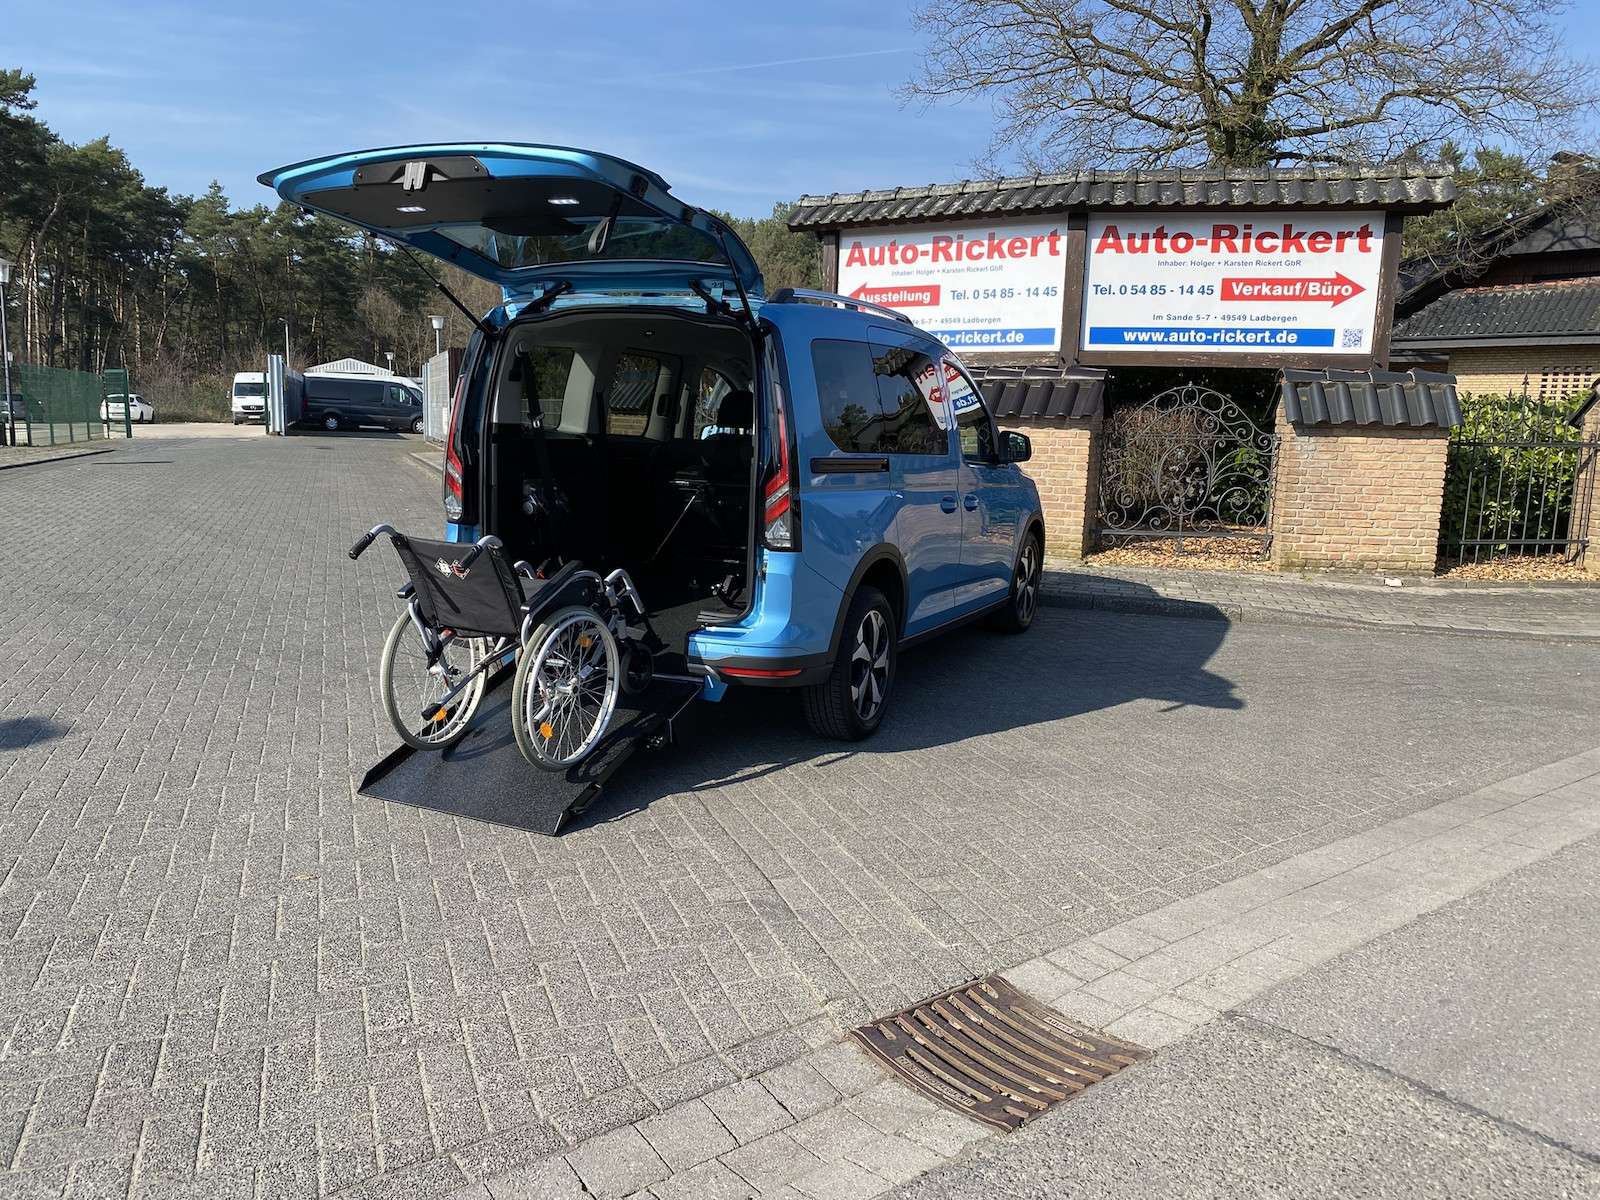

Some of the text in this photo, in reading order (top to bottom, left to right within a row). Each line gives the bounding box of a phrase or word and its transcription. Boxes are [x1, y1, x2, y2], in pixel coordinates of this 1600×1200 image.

[1095, 223, 1373, 255] Auto-Rickert
[846, 228, 1061, 268] Auto-Rickert
[1190, 259, 1215, 268] Holger
[1223, 259, 1253, 267] Karsten
[1255, 259, 1283, 267] Rickert
[1284, 259, 1302, 267] GbR
[950, 289, 969, 300] Tel.
[972, 289, 980, 300] 0
[982, 288, 997, 299] 54
[999, 287, 1014, 299] 85
[1025, 287, 1040, 297] 14
[1042, 286, 1058, 297] 45
[1093, 284, 1116, 295] Tel.
[1119, 284, 1128, 295] 0
[1130, 284, 1147, 295] 54
[1149, 284, 1167, 295] 85
[1178, 285, 1195, 295] 14
[1197, 285, 1214, 295] 45
[1231, 281, 1353, 297] Verkauf/Büro
[859, 289, 931, 304] Ausstellung
[962, 316, 1001, 324] Ladbergen
[1166, 313, 1193, 321] Sande
[1249, 314, 1298, 323] Ladbergen
[1123, 329, 1298, 344] www.auto-rickert.de
